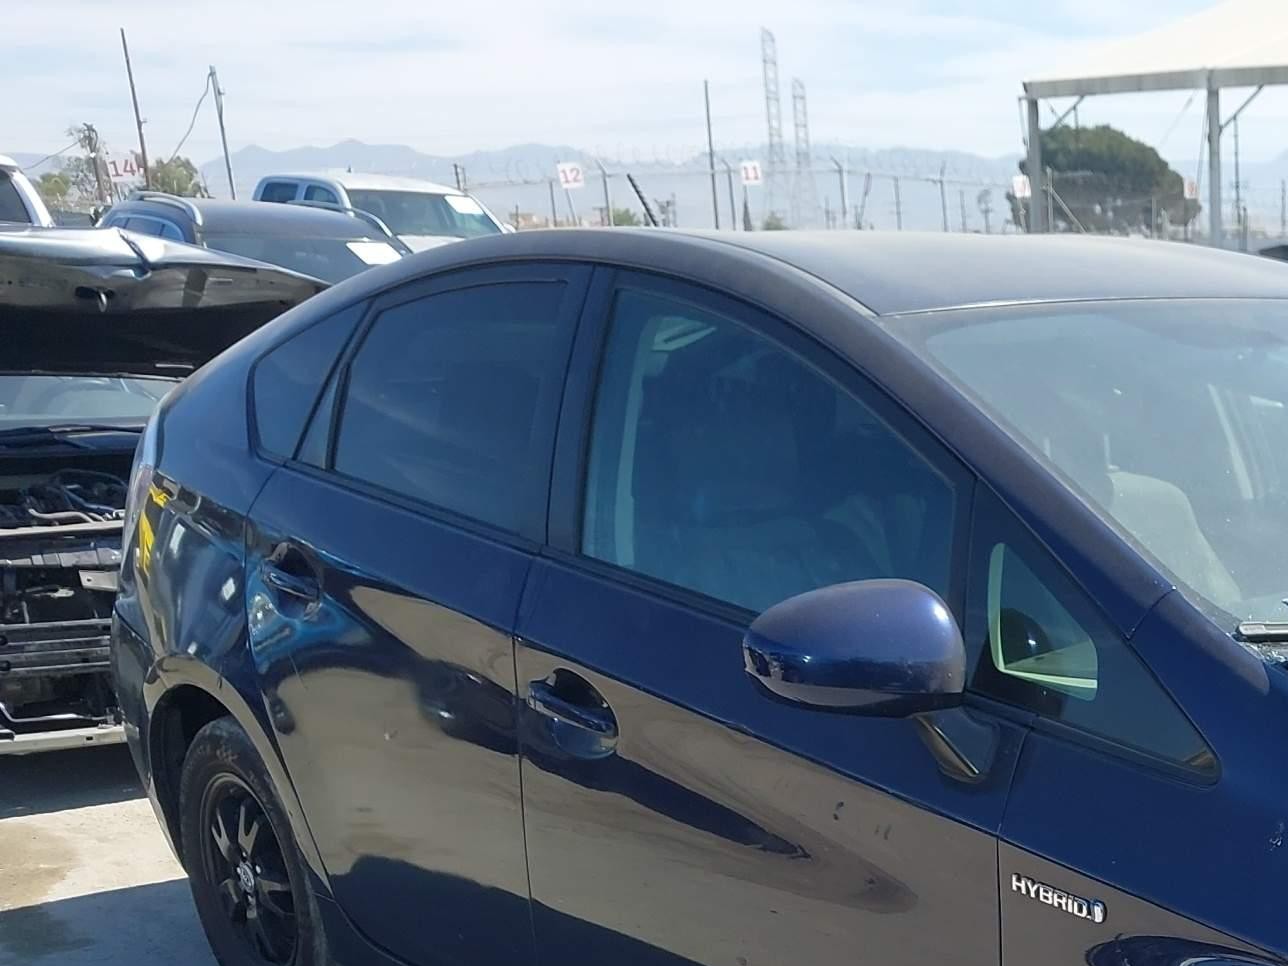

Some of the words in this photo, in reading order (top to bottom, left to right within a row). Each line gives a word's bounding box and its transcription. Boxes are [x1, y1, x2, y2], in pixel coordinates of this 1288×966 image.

[108, 159, 137, 177] 14
[560, 167, 581, 184] 12
[1011, 873, 1089, 919] HYBRID
